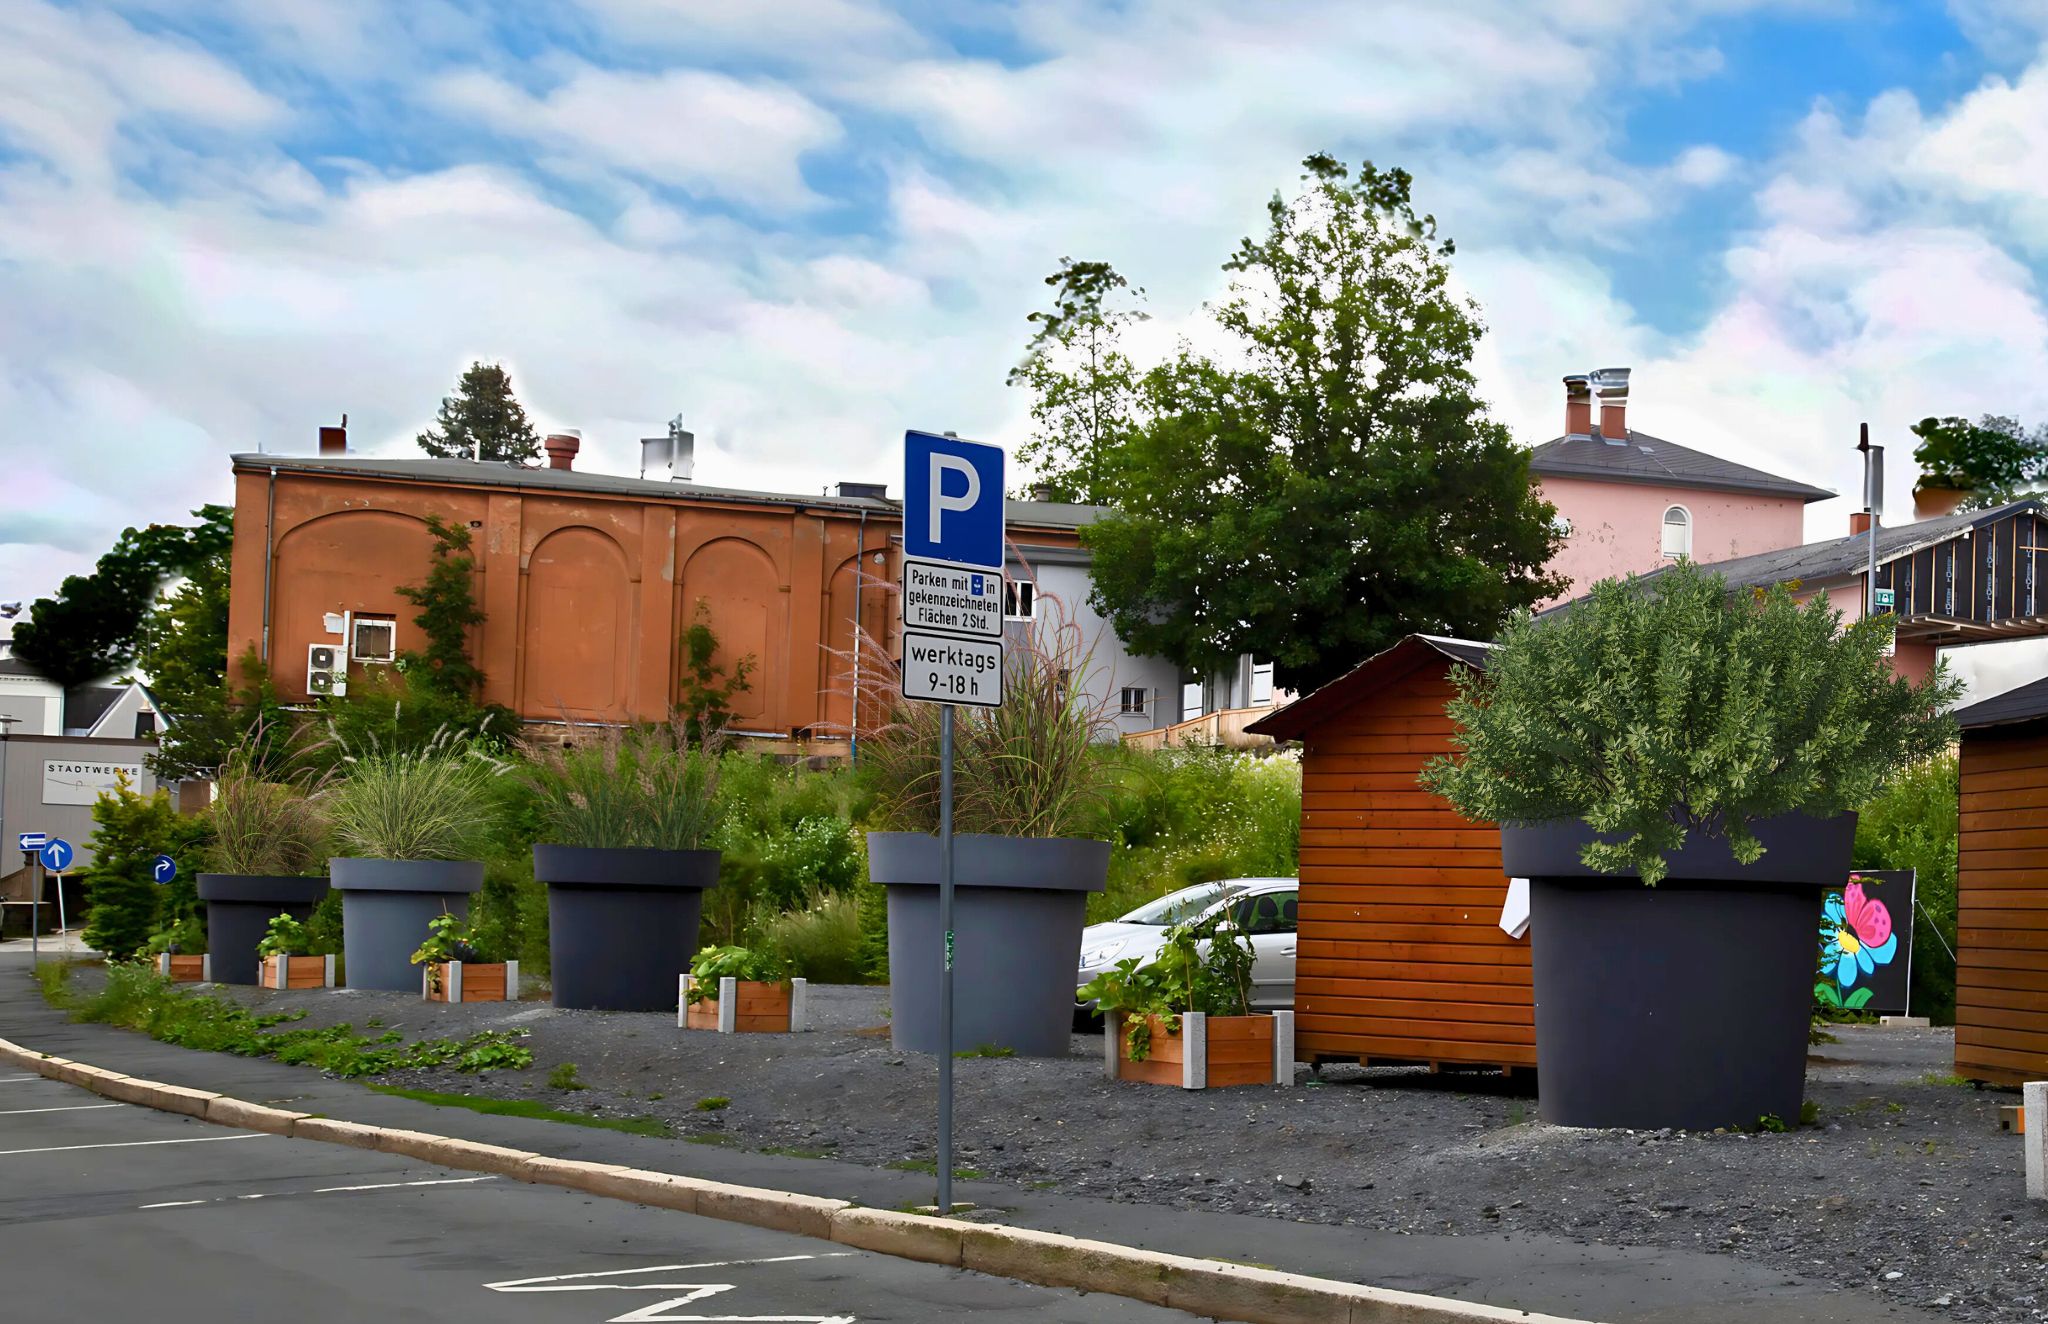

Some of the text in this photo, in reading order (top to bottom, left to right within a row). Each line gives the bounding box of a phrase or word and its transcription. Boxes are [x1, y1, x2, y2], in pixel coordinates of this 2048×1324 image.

[929, 451, 981, 543] P
[912, 570, 995, 594] Parken mit in
[909, 589, 998, 613] gekennzeichneten
[918, 608, 989, 630] Flächen 2 Std.
[911, 646, 996, 673] werktags
[929, 672, 978, 696] 9-18 h
